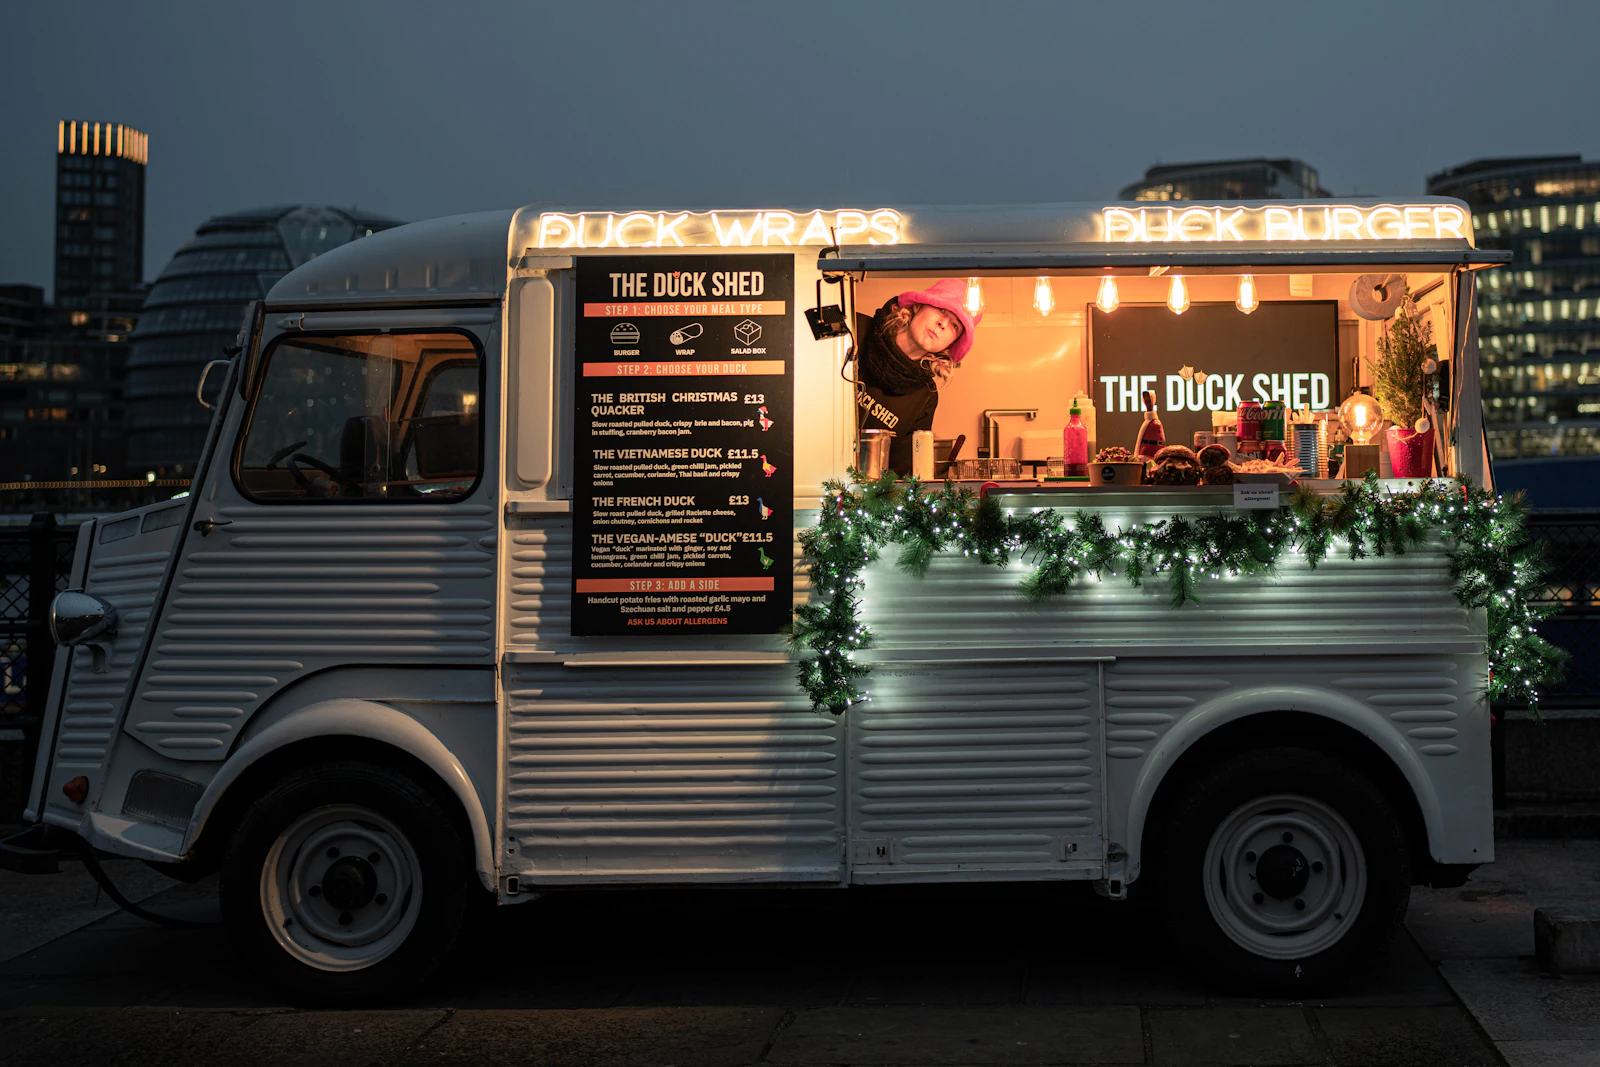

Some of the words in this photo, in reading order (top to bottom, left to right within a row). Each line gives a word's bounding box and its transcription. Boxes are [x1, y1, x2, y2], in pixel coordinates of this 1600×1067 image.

[538, 212, 689, 248] DUCK
[710, 209, 902, 246] WRAPS
[1103, 208, 1243, 242] DUCK
[1264, 206, 1464, 240] BURGER
[609, 273, 647, 297] THE
[654, 272, 707, 297] DUCK
[712, 272, 764, 296] SHED
[606, 306, 631, 315] STEP
[633, 305, 641, 315] 1:
[645, 305, 679, 315] CHOOSE
[684, 305, 708, 314] YOUR
[712, 304, 736, 314] MEAL
[740, 304, 762, 314] TYPE
[618, 365, 640, 375] STEP
[644, 365, 652, 374] 2:
[656, 364, 692, 374] CHOOSE
[696, 364, 720, 374] YOUR
[723, 364, 747, 373] DUCK
[1100, 375, 1157, 412] THE
[1166, 374, 1245, 412] DUCK
[1252, 372, 1330, 410] SHED
[591, 394, 613, 403] THE
[620, 393, 666, 403] BRITISH
[672, 392, 738, 402] CHRISTMAS
[744, 395, 764, 404] £13
[591, 405, 645, 417] QUACKER
[871, 404, 899, 429] SHED
[634, 421, 653, 429] pulled
[673, 420, 692, 428] crispy
[744, 419, 754, 427] pig
[599, 429, 625, 437] stuffing,
[677, 428, 692, 436] jam.
[593, 450, 615, 459] THE
[617, 449, 689, 459] VIETNAMESE
[691, 449, 722, 458] DUCK
[728, 449, 758, 458] £11.5
[654, 463, 670, 471] duck,
[705, 463, 719, 471] jam,
[721, 471, 740, 479] crispy
[593, 497, 615, 507] THE
[617, 497, 662, 506] FRENCH
[664, 497, 695, 506] DUCK
[729, 496, 749, 505] £13
[627, 510, 646, 518] pulled
[665, 510, 685, 518] grilled
[611, 518, 636, 526] chutney,
[592, 534, 614, 544] THE
[616, 534, 697, 543] VEGAN-AMESE
[742, 533, 773, 542] £11.5
[684, 545, 705, 553] ginger,
[667, 553, 681, 561] jam,
[683, 553, 705, 561] pickled
[666, 561, 684, 569] crispy
[630, 581, 652, 590] STEP
[656, 581, 665, 590] 3:
[668, 580, 686, 590] ADD
[690, 580, 695, 590] A
[699, 580, 719, 590] SIDE
[620, 596, 644, 605] potato
[709, 596, 730, 604] garlic
